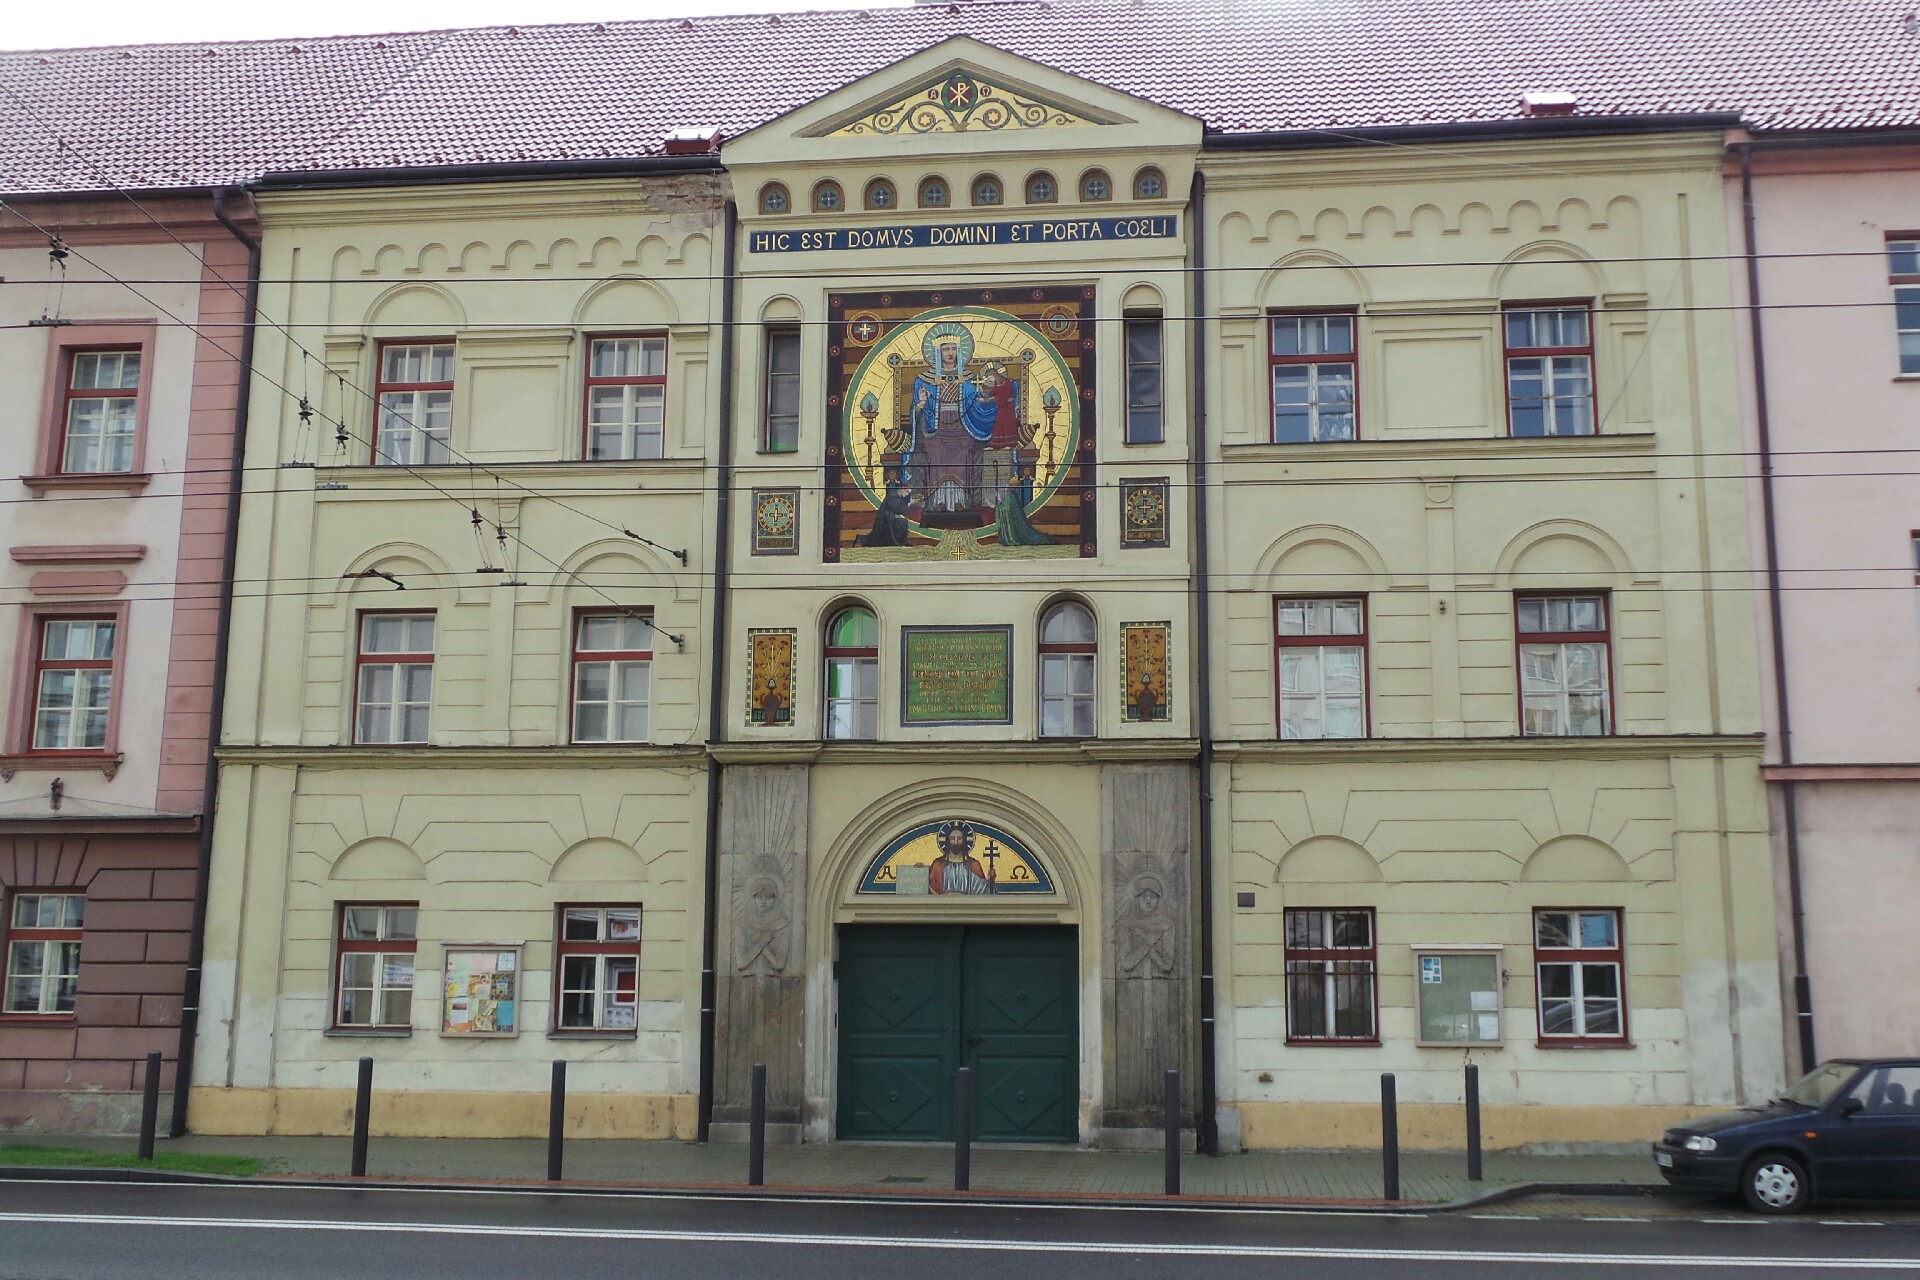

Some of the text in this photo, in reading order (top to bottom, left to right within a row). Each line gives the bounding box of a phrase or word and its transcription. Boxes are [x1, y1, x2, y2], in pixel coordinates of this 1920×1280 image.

[756, 218, 1167, 251] HIC EST DOMVS DOMINI ET PORTA COELI
